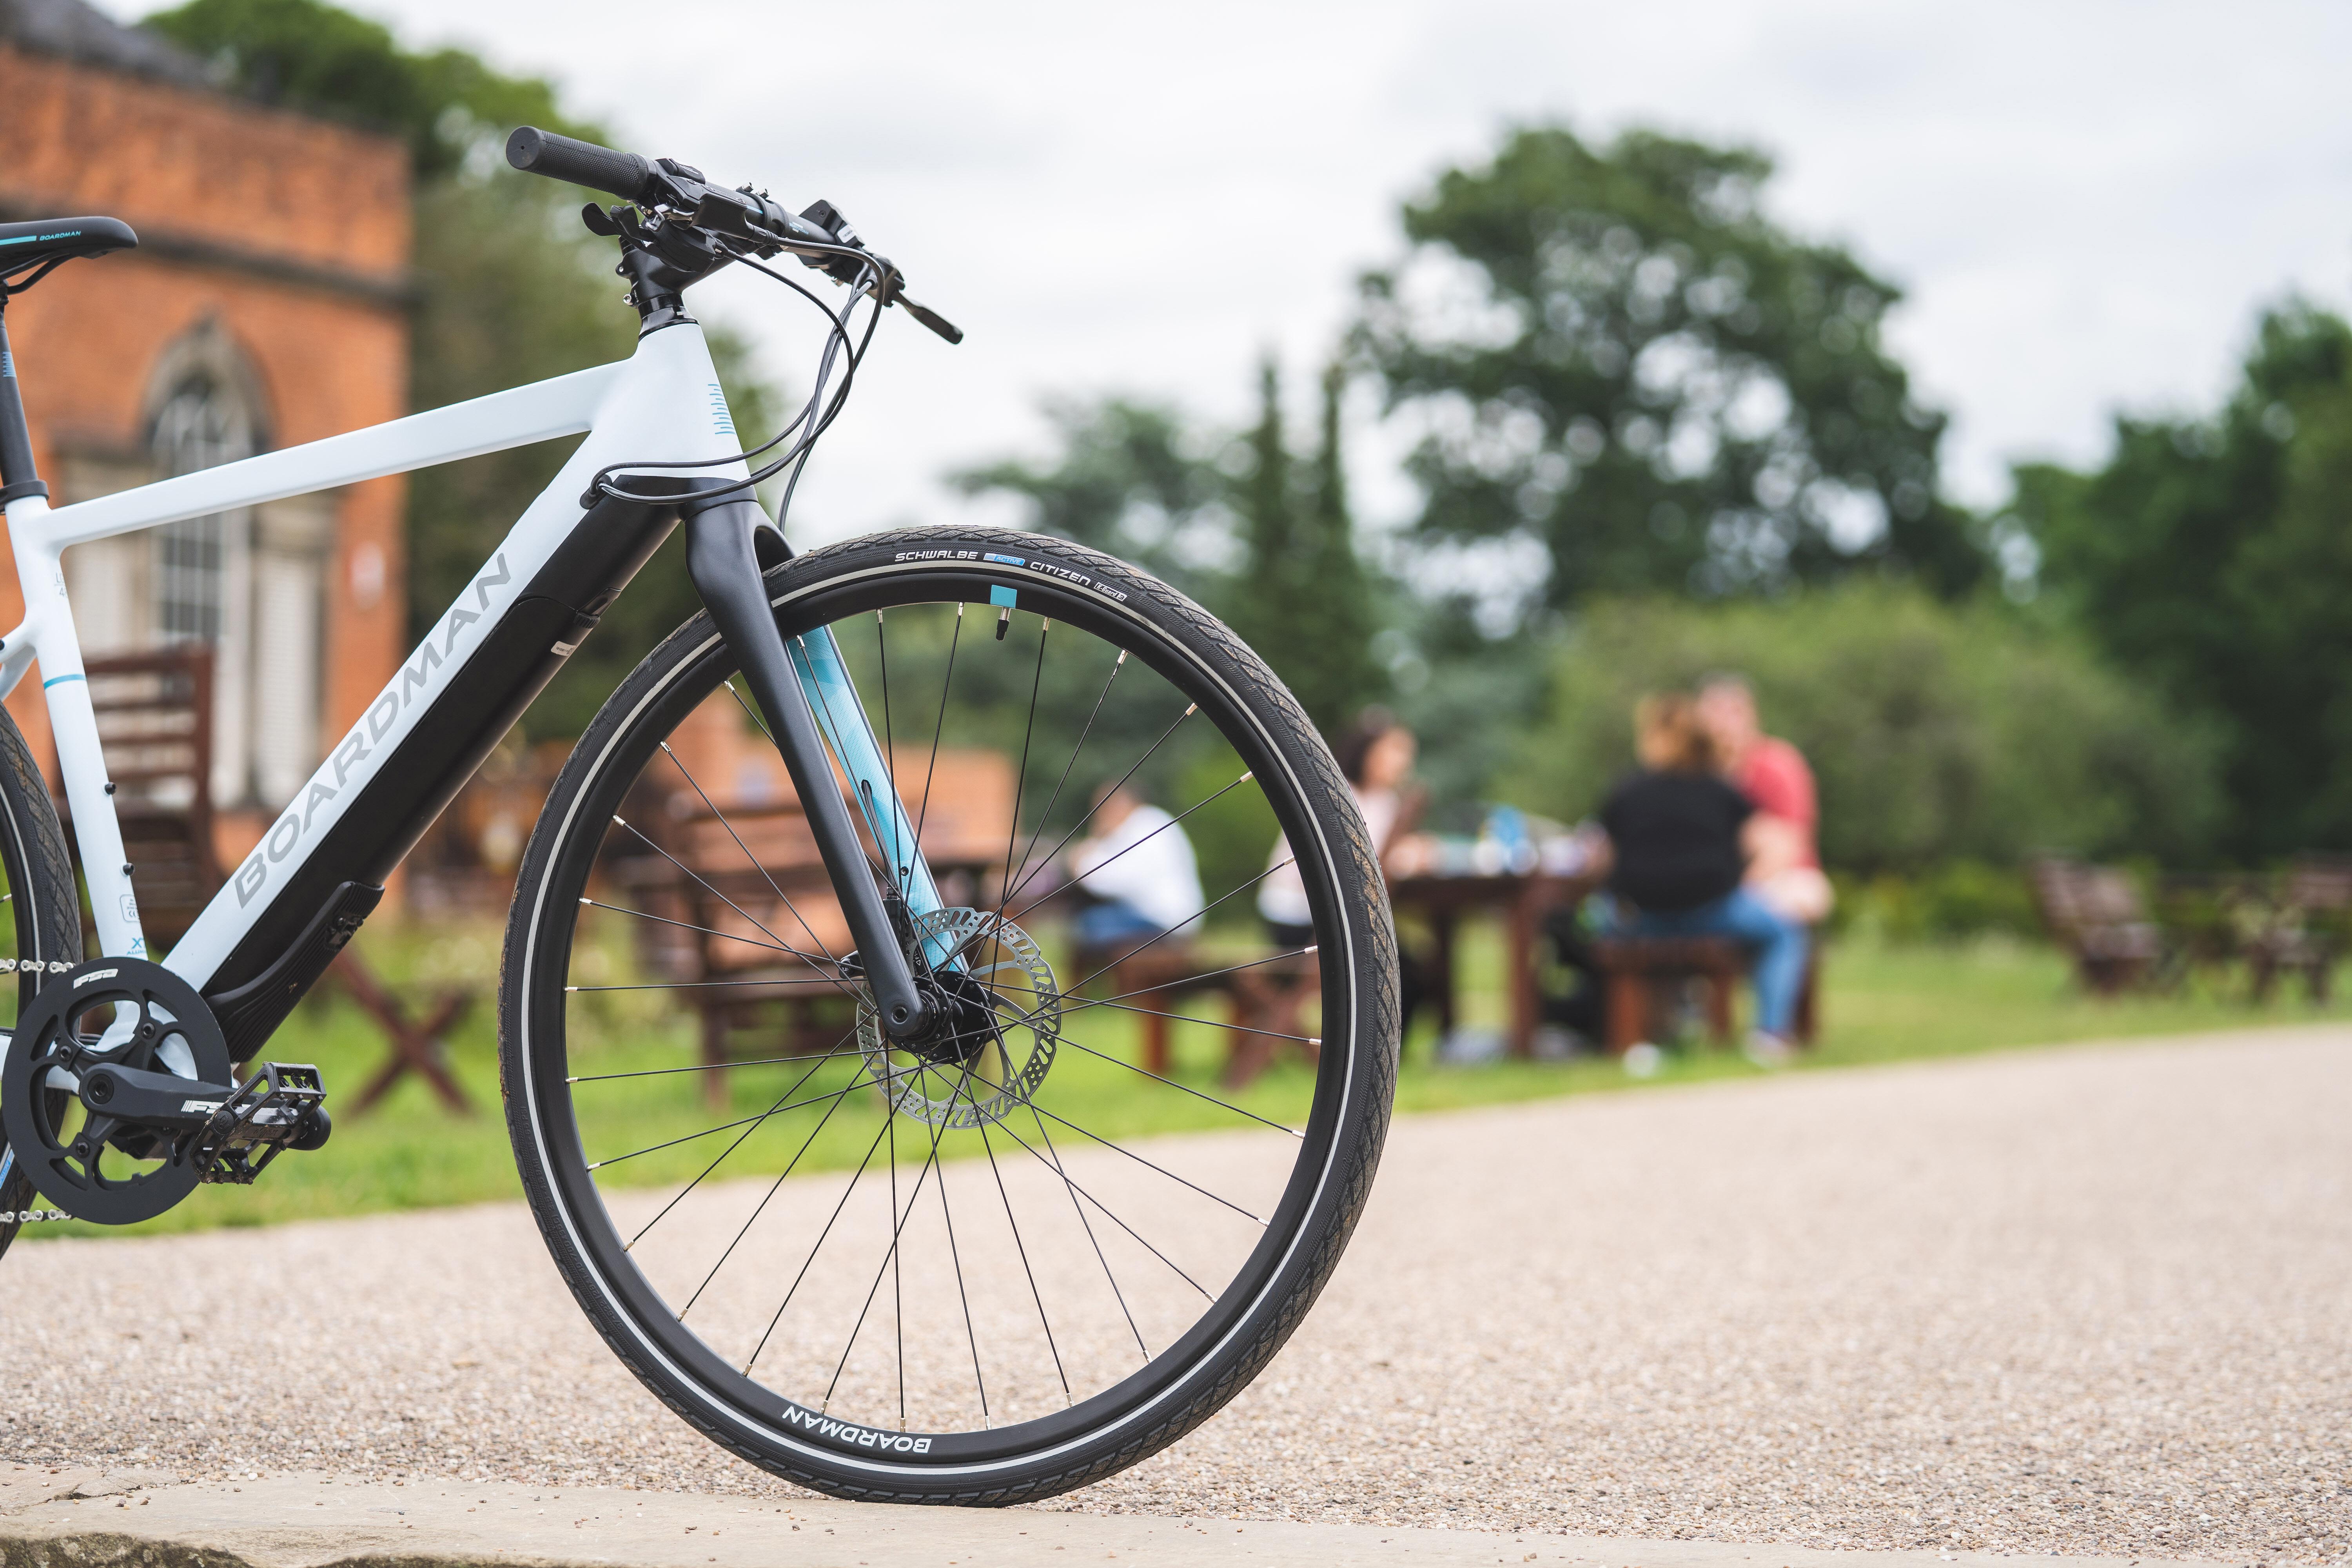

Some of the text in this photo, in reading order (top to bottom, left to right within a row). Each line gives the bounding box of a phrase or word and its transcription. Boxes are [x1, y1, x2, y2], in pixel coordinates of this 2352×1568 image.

[40, 230, 81, 241] BOARDMAN
[895, 550, 1091, 586] SCHWALBE ACTIVE CITIZEN
[1096, 584, 1117, 597] K-Guard
[234, 553, 511, 909] BOARDMAN
[782, 1405, 932, 1453] BOARDMAN
